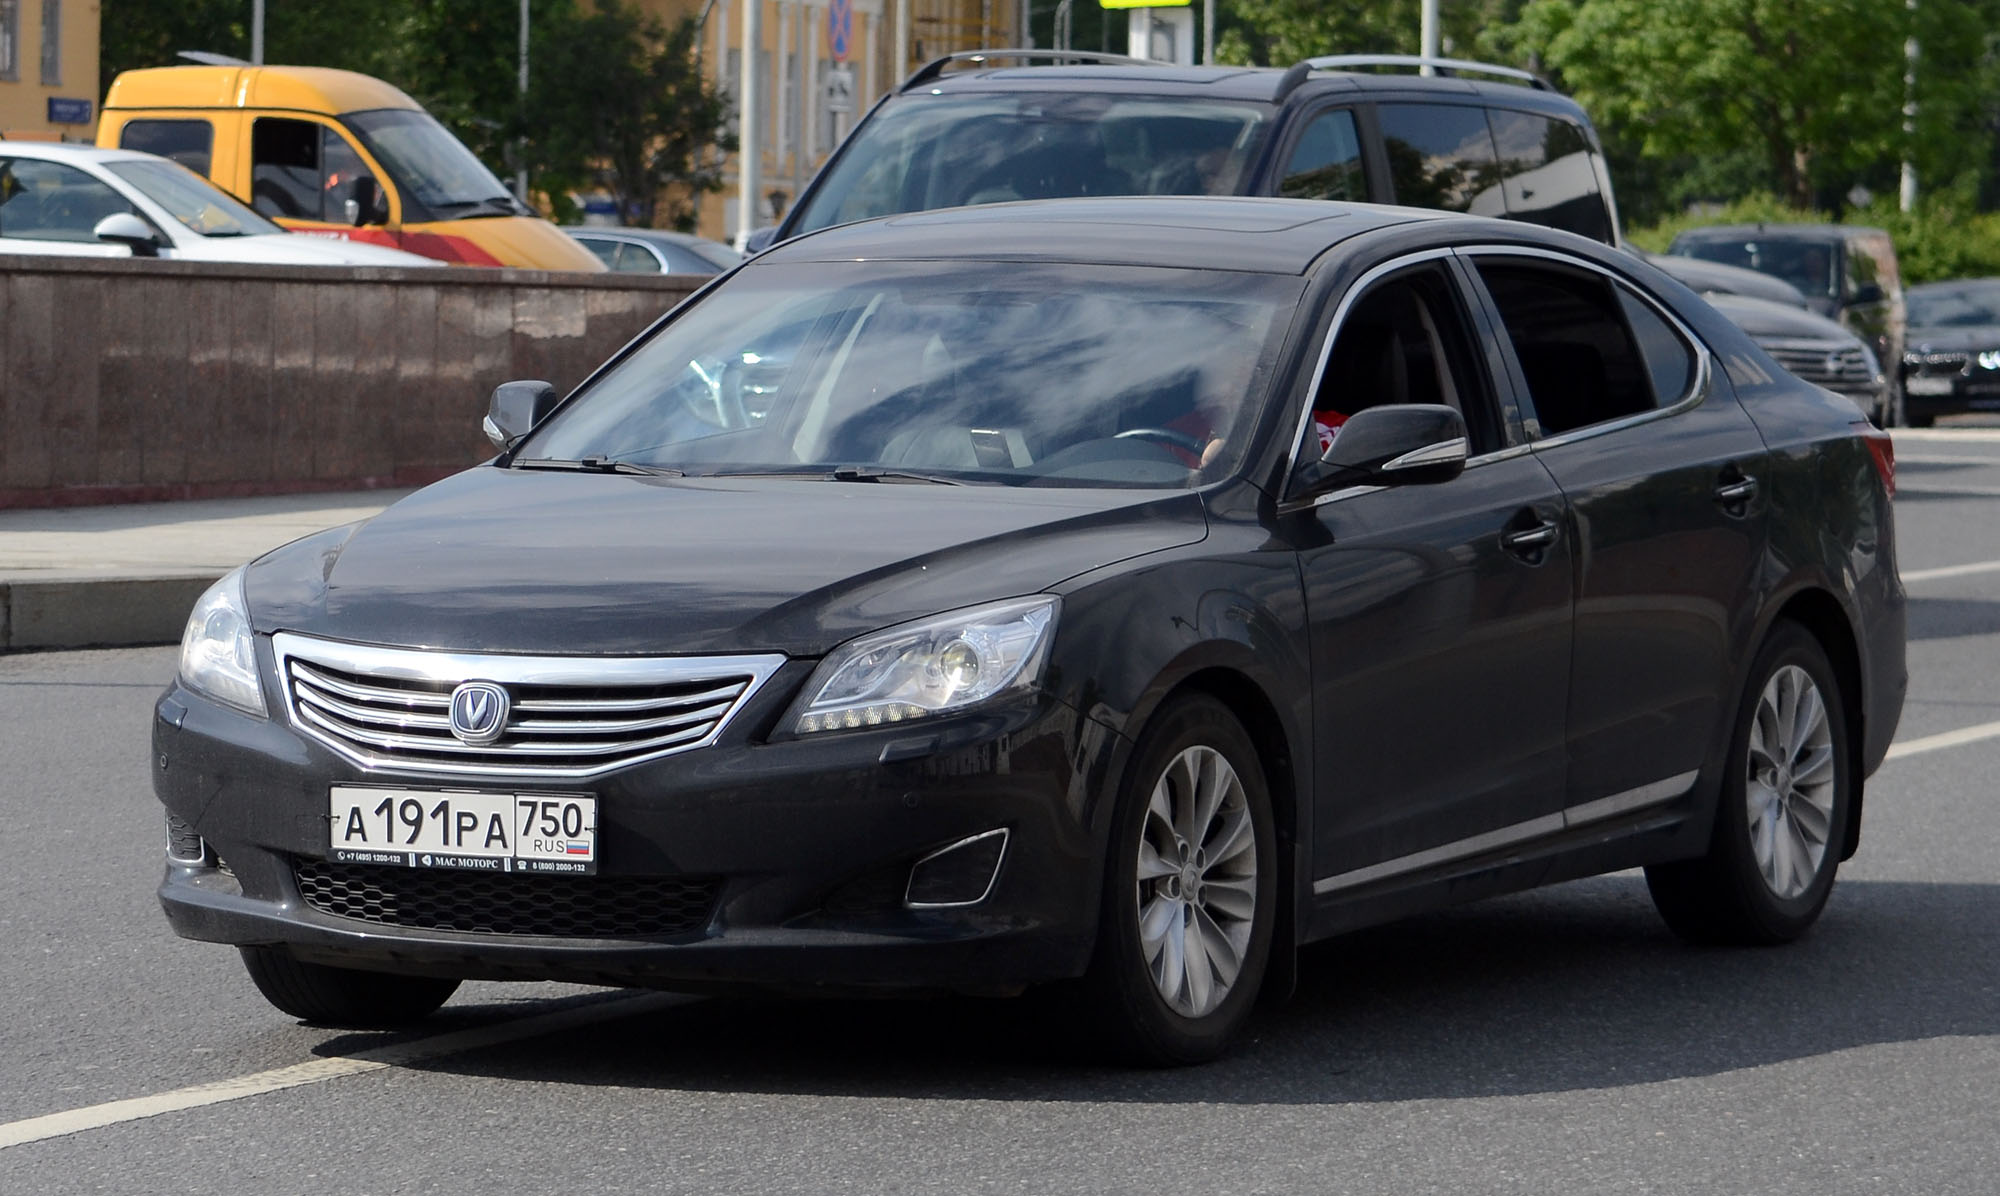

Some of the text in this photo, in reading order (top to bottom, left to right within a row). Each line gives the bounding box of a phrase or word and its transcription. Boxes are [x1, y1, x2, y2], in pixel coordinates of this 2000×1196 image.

[345, 797, 582, 849] А191РА 750
[533, 839, 565, 853] RUS
[435, 857, 456, 866] МАС
[458, 857, 498, 869] МОТОРС
